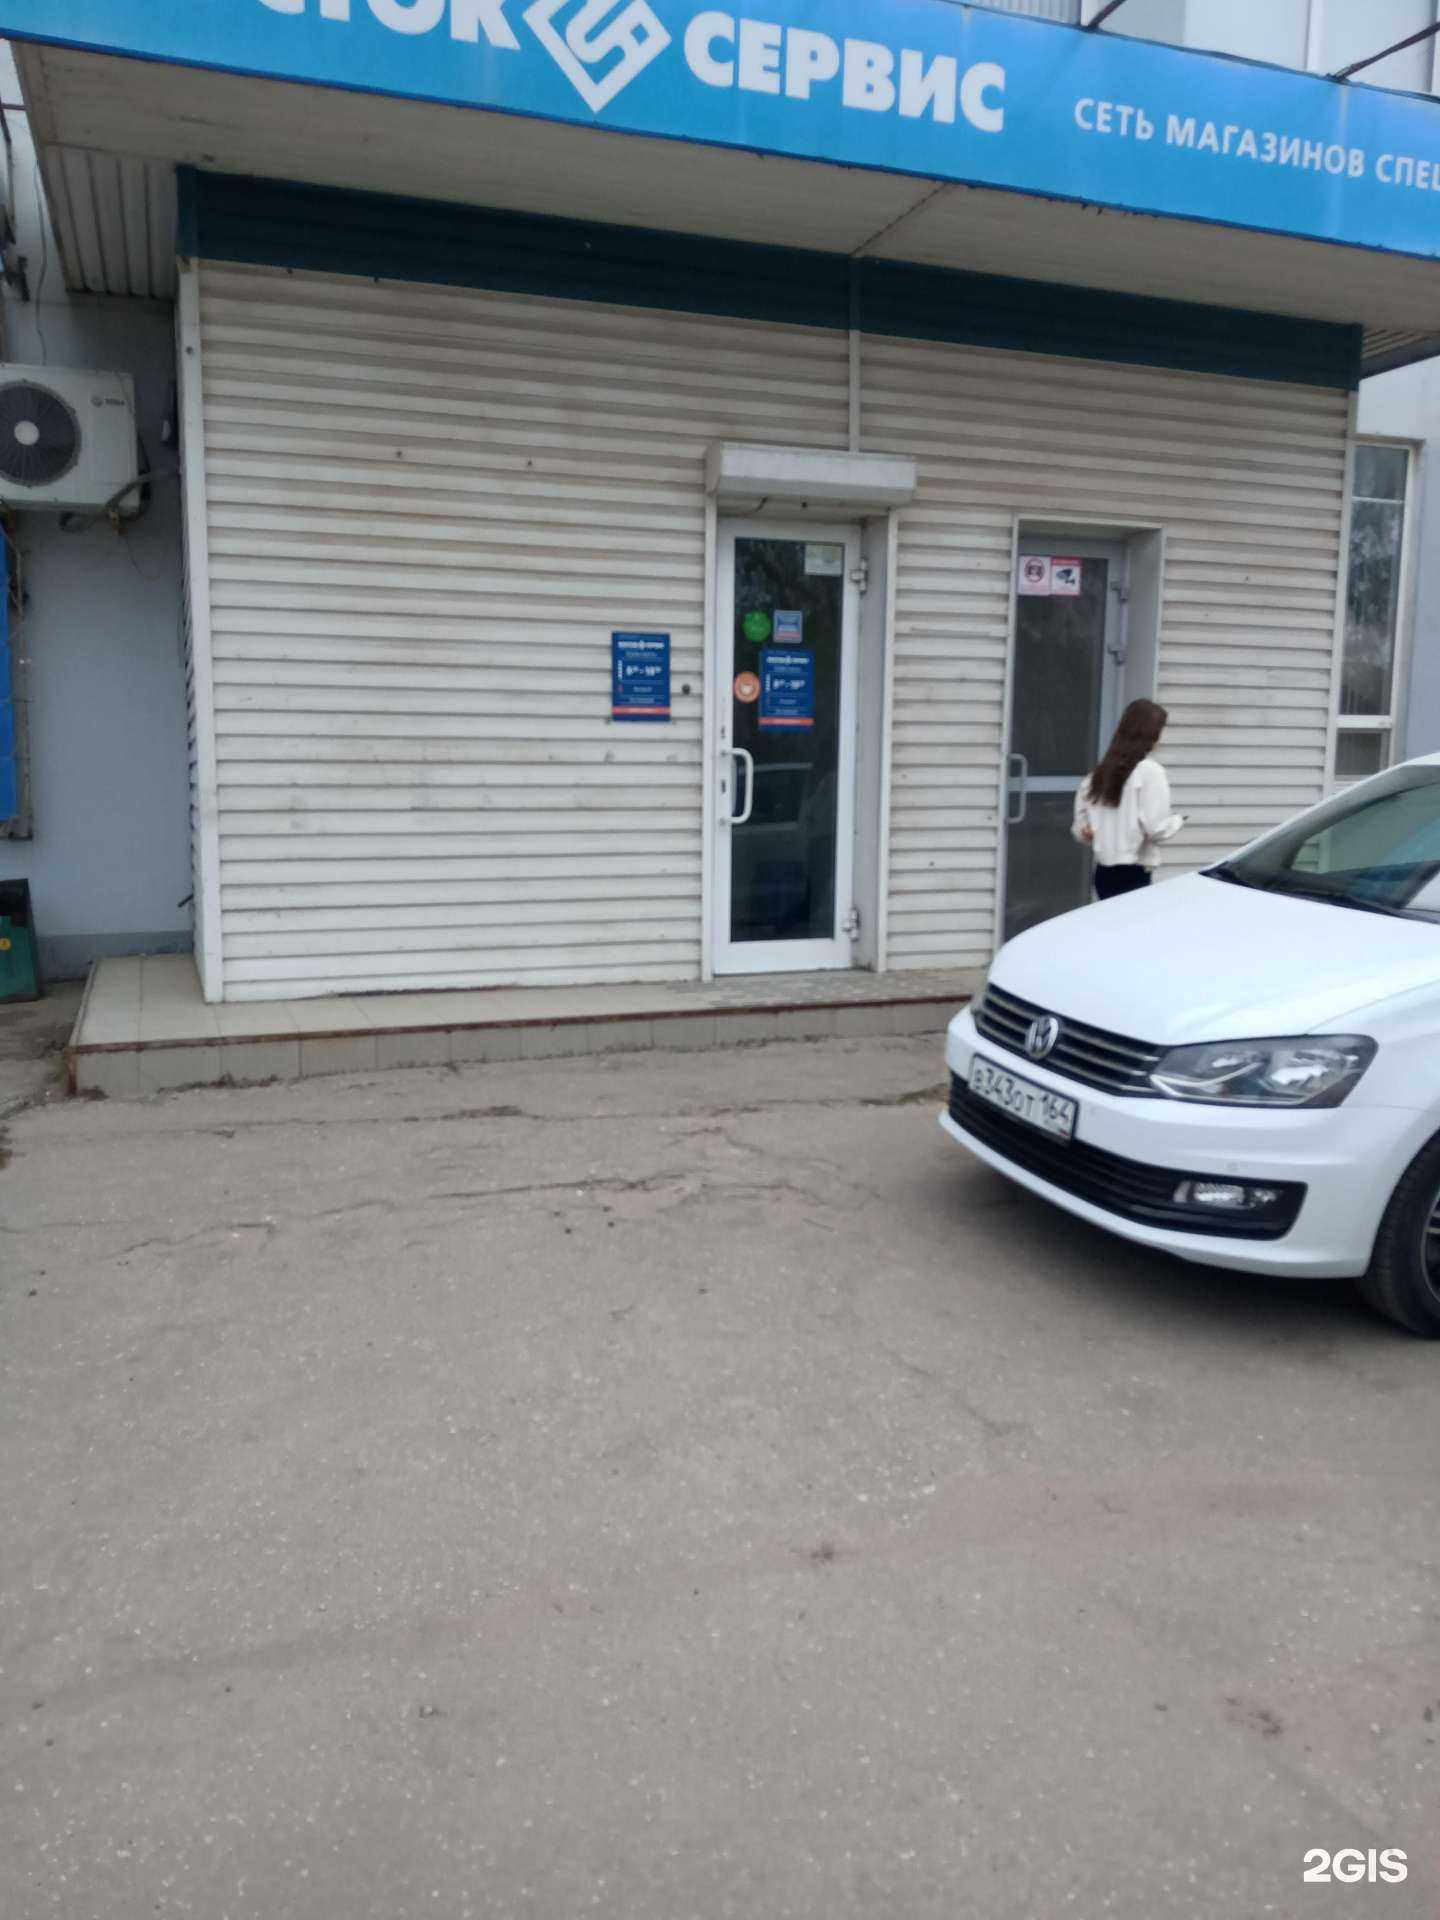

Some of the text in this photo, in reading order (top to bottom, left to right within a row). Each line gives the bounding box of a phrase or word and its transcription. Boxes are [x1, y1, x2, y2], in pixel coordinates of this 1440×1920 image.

[683, 10, 1006, 133] СЕРВИС
[1073, 97, 1154, 141] СЕТЬ
[1165, 113, 1365, 178] МАГАЗИНОВ
